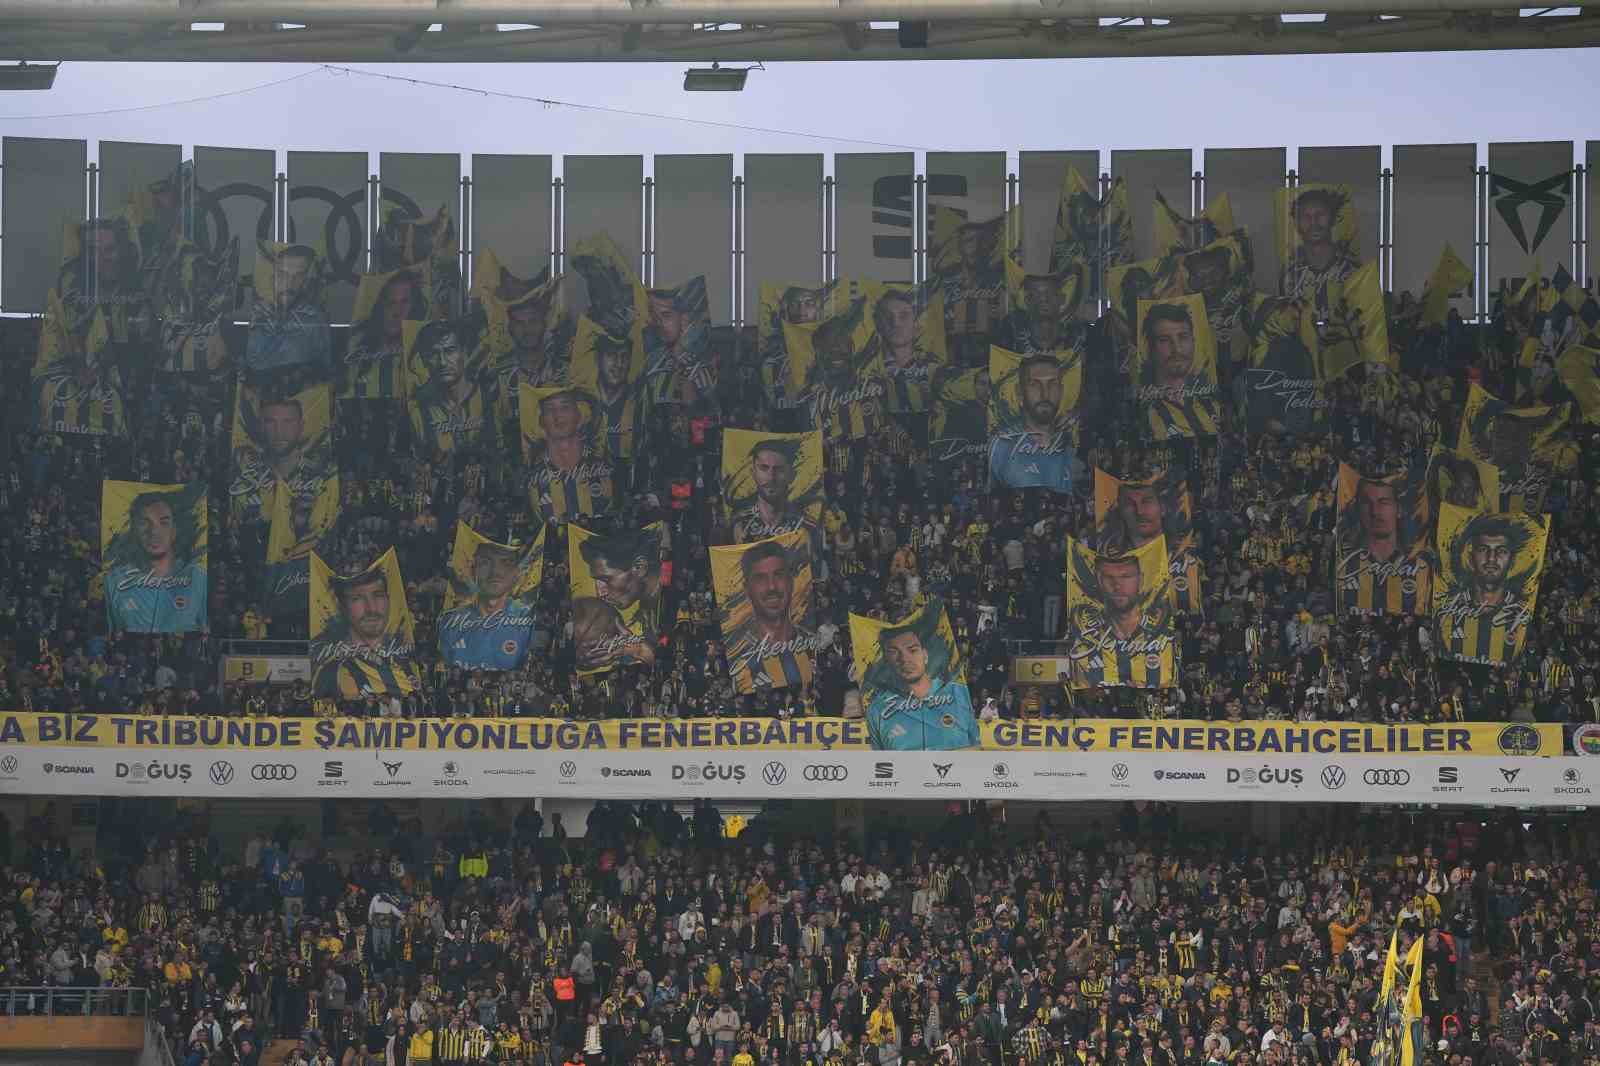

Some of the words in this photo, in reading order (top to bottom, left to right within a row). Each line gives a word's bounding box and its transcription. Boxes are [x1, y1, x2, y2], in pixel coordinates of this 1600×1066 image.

[118, 566, 194, 592] Ederson
[242, 662, 254, 676] B
[1031, 662, 1044, 676] C
[881, 690, 955, 720] Ederson
[993, 723, 1095, 752] GENÇ
[612, 768, 652, 777] SCANIA
[1165, 770, 1206, 780] SCANIA
